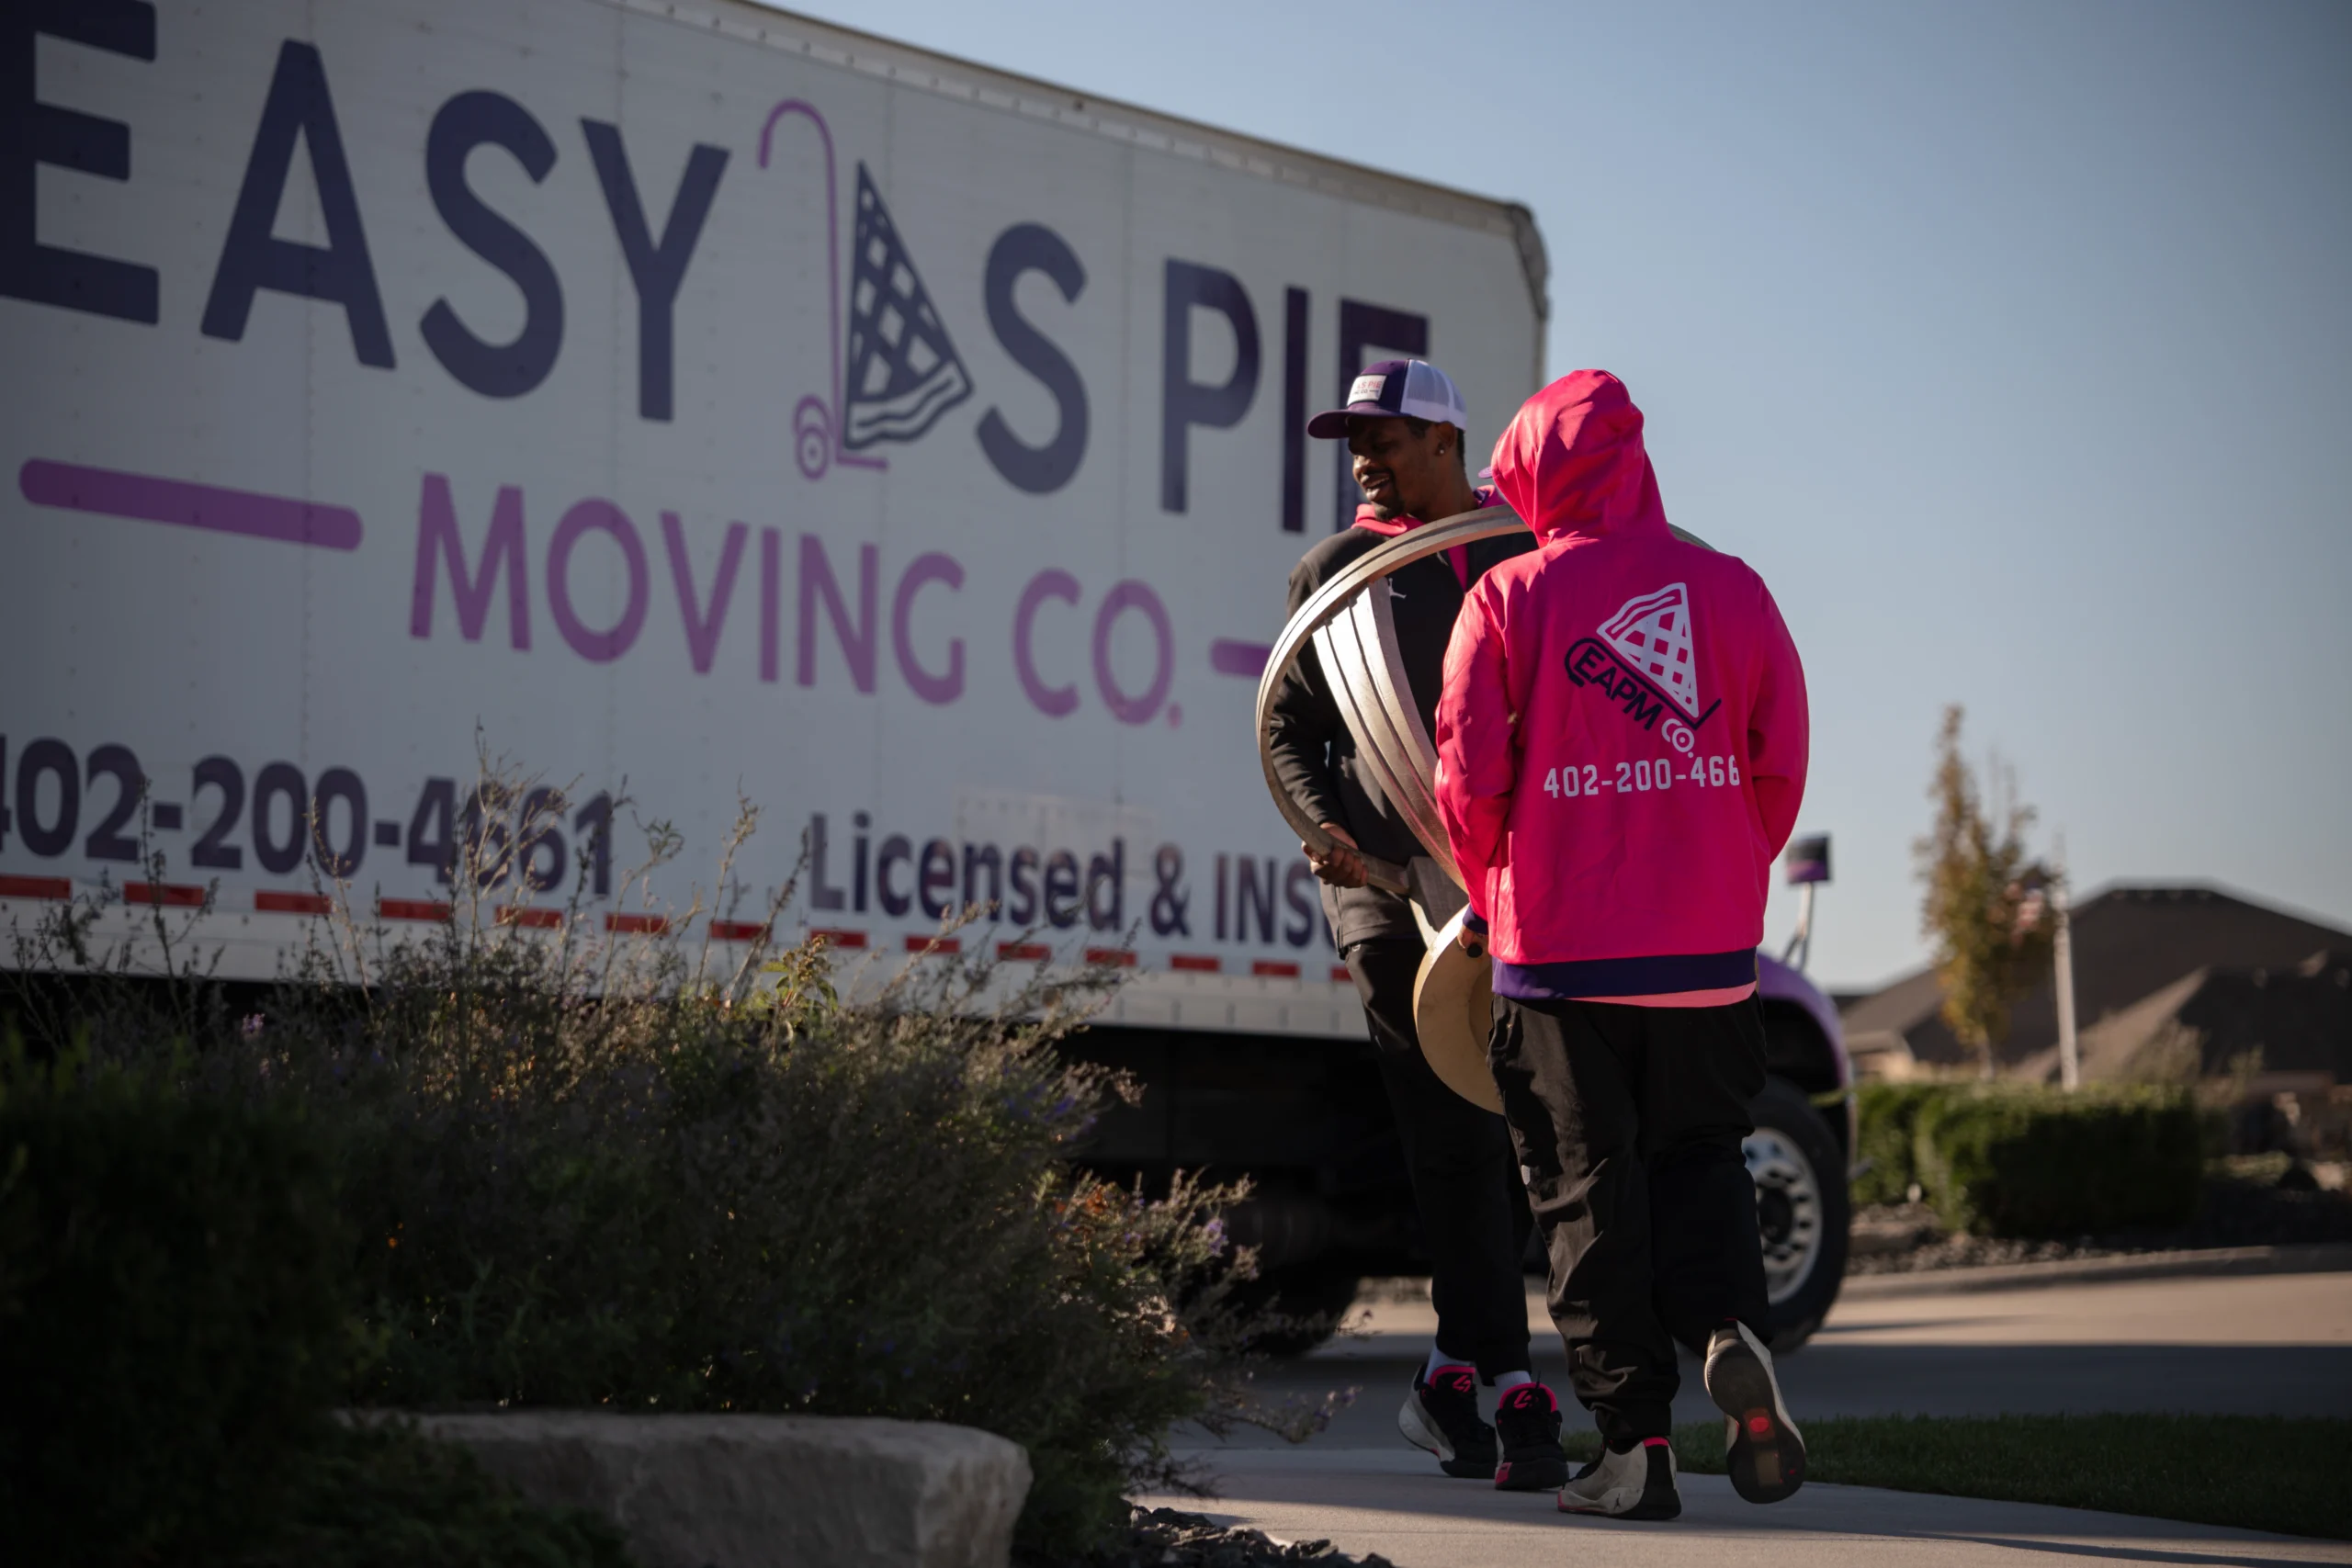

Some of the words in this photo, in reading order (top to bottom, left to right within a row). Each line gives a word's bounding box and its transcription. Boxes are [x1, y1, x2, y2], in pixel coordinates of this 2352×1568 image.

[0, 0, 731, 423] EASY
[410, 472, 966, 705] MOVING
[1013, 568, 1182, 728] CO.
[1574, 646, 1662, 730] EAPM
[0, 733, 611, 895] 02-200-4661
[809, 810, 1125, 926] Licensed
[1149, 846, 1191, 939] &
[1216, 852, 1335, 951] INS
